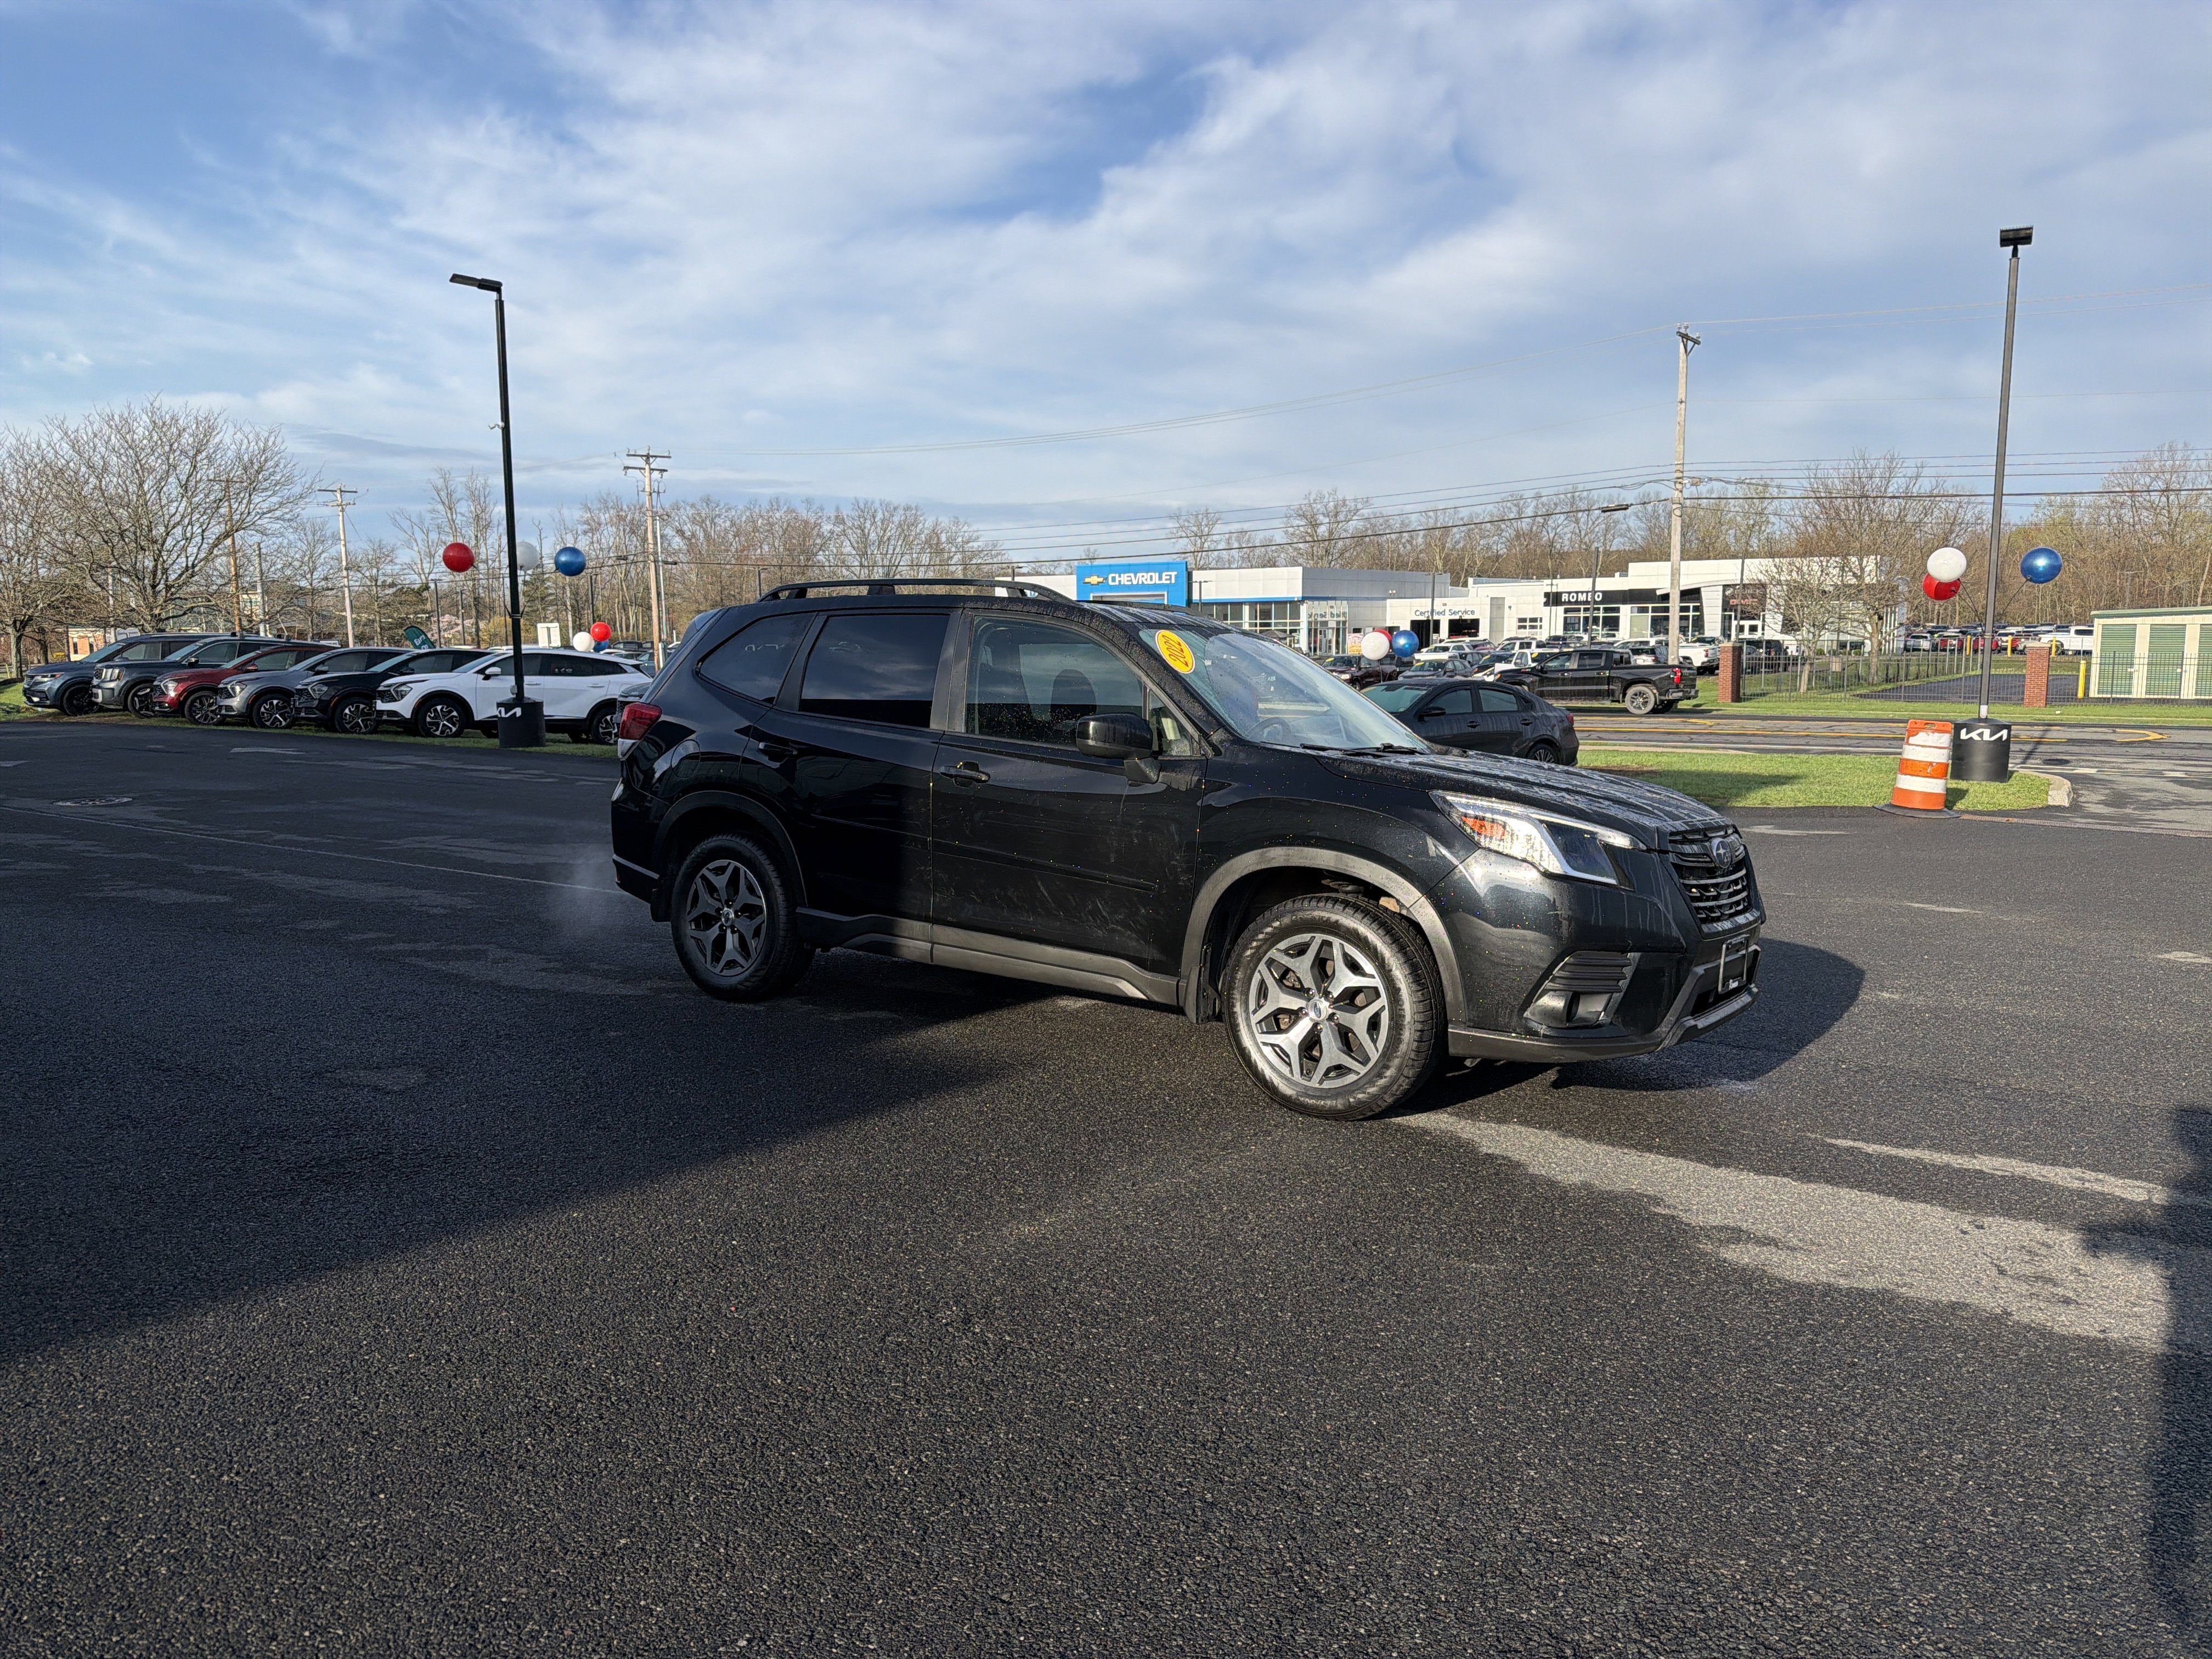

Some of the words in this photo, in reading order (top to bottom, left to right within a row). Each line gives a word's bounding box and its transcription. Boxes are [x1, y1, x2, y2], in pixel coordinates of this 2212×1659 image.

[1108, 572, 1177, 585] CHEVROLET
[1448, 608, 1475, 616] Service
[1161, 634, 1189, 668] 2022
[1960, 728, 2008, 741] KIA
